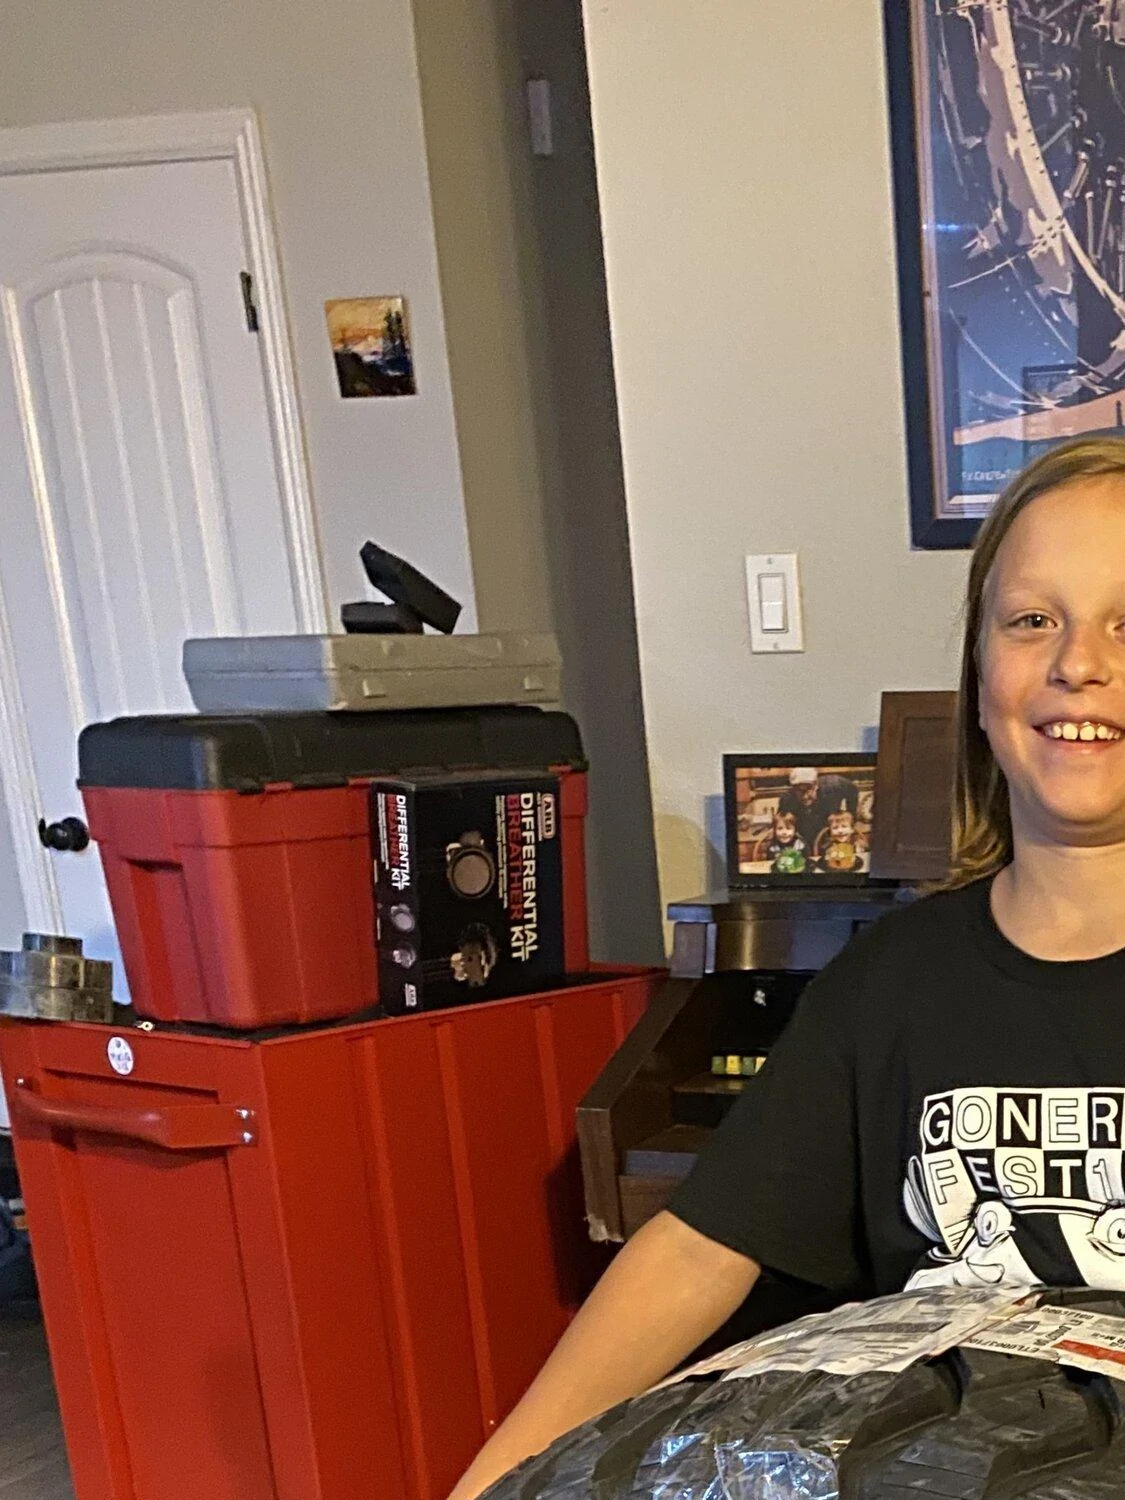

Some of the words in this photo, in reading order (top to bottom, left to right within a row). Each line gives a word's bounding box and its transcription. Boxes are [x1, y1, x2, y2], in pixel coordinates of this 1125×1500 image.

[386, 794, 400, 866] BREATHER
[396, 794, 411, 888] DIFFERENTIAL
[506, 794, 523, 920] BREATHER
[391, 867, 405, 891] KIT
[520, 792, 539, 951] DIFFERENTIAL
[510, 926, 530, 962] KIT
[923, 1095, 1120, 1147] GONER
